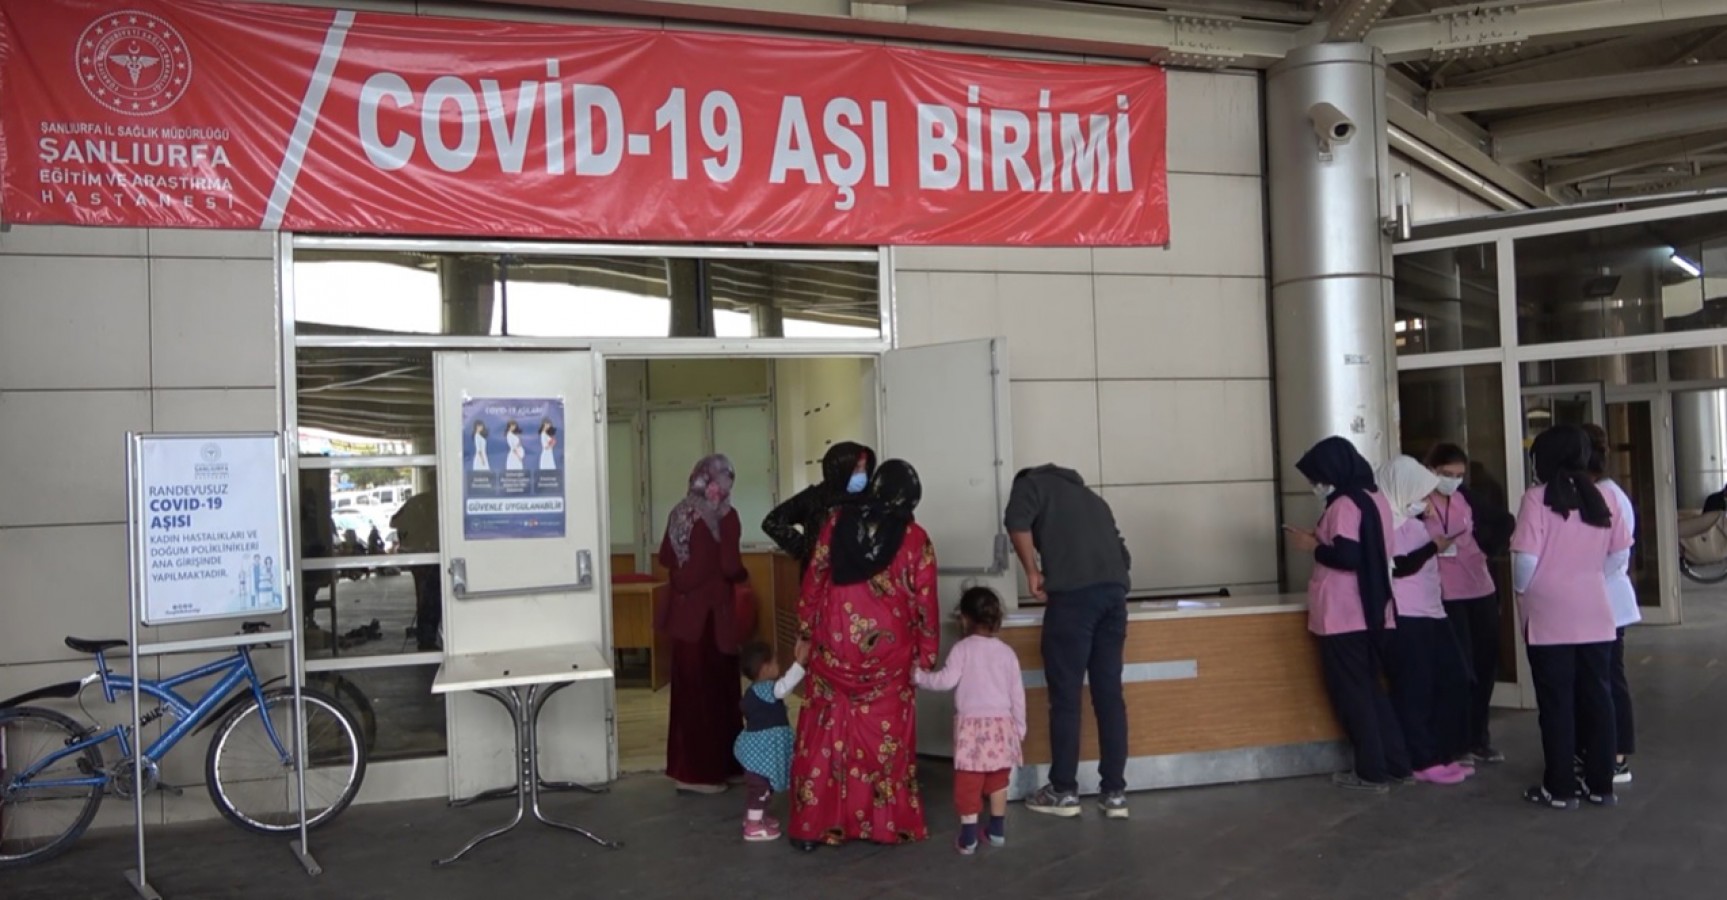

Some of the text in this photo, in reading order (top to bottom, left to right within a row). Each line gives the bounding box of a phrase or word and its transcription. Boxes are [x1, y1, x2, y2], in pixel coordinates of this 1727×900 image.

[41, 122, 230, 141] ŞANLIURFA İL SAĞLIK MÜDÜRLÜĞÜ
[358, 57, 1134, 211] COVİD-19 AŞI BİRİMİ
[39, 138, 231, 168] ŞANLIURFA
[40, 168, 233, 191] EĞİTİM VE ARAŞTIRMA
[41, 191, 234, 209] HASTANESİ
[149, 484, 229, 497] RANDEVUSUZ
[150, 497, 223, 512] COVID-19
[468, 500, 562, 512] GÜVENLE UYGULANABİLİR
[151, 515, 191, 532] AŞISI
[150, 530, 257, 544] KADIN HASTALIKLARI VE
[150, 545, 189, 557] DOĞUM
[151, 556, 222, 568] ANA GİRİŞİNDE
